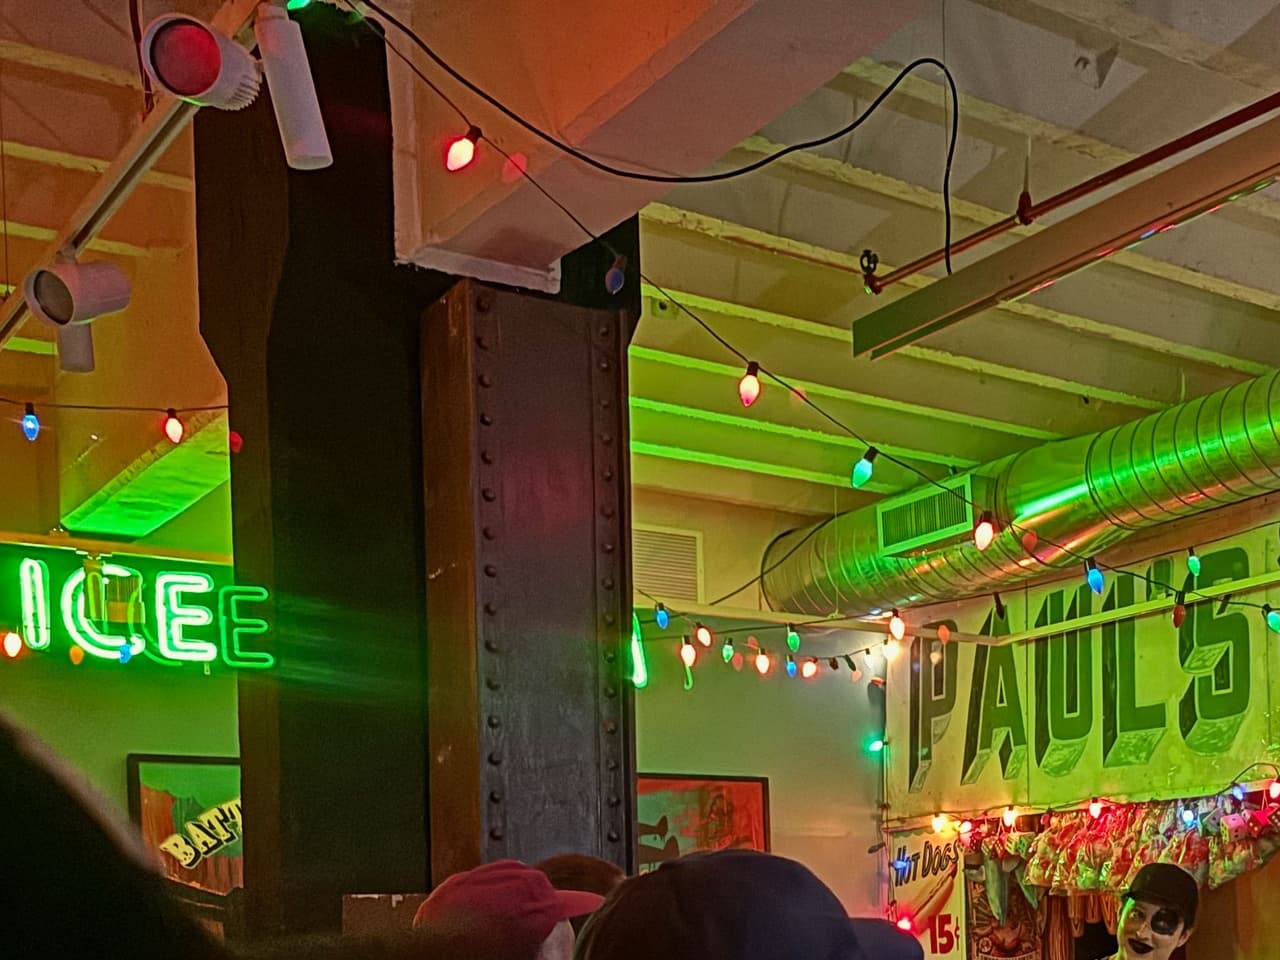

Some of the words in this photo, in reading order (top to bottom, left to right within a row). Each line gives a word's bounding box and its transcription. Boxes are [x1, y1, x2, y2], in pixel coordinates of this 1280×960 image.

[908, 547, 1251, 793] PAUL'S
[895, 845, 920, 887] HOT
[921, 840, 960, 878] DOGS
